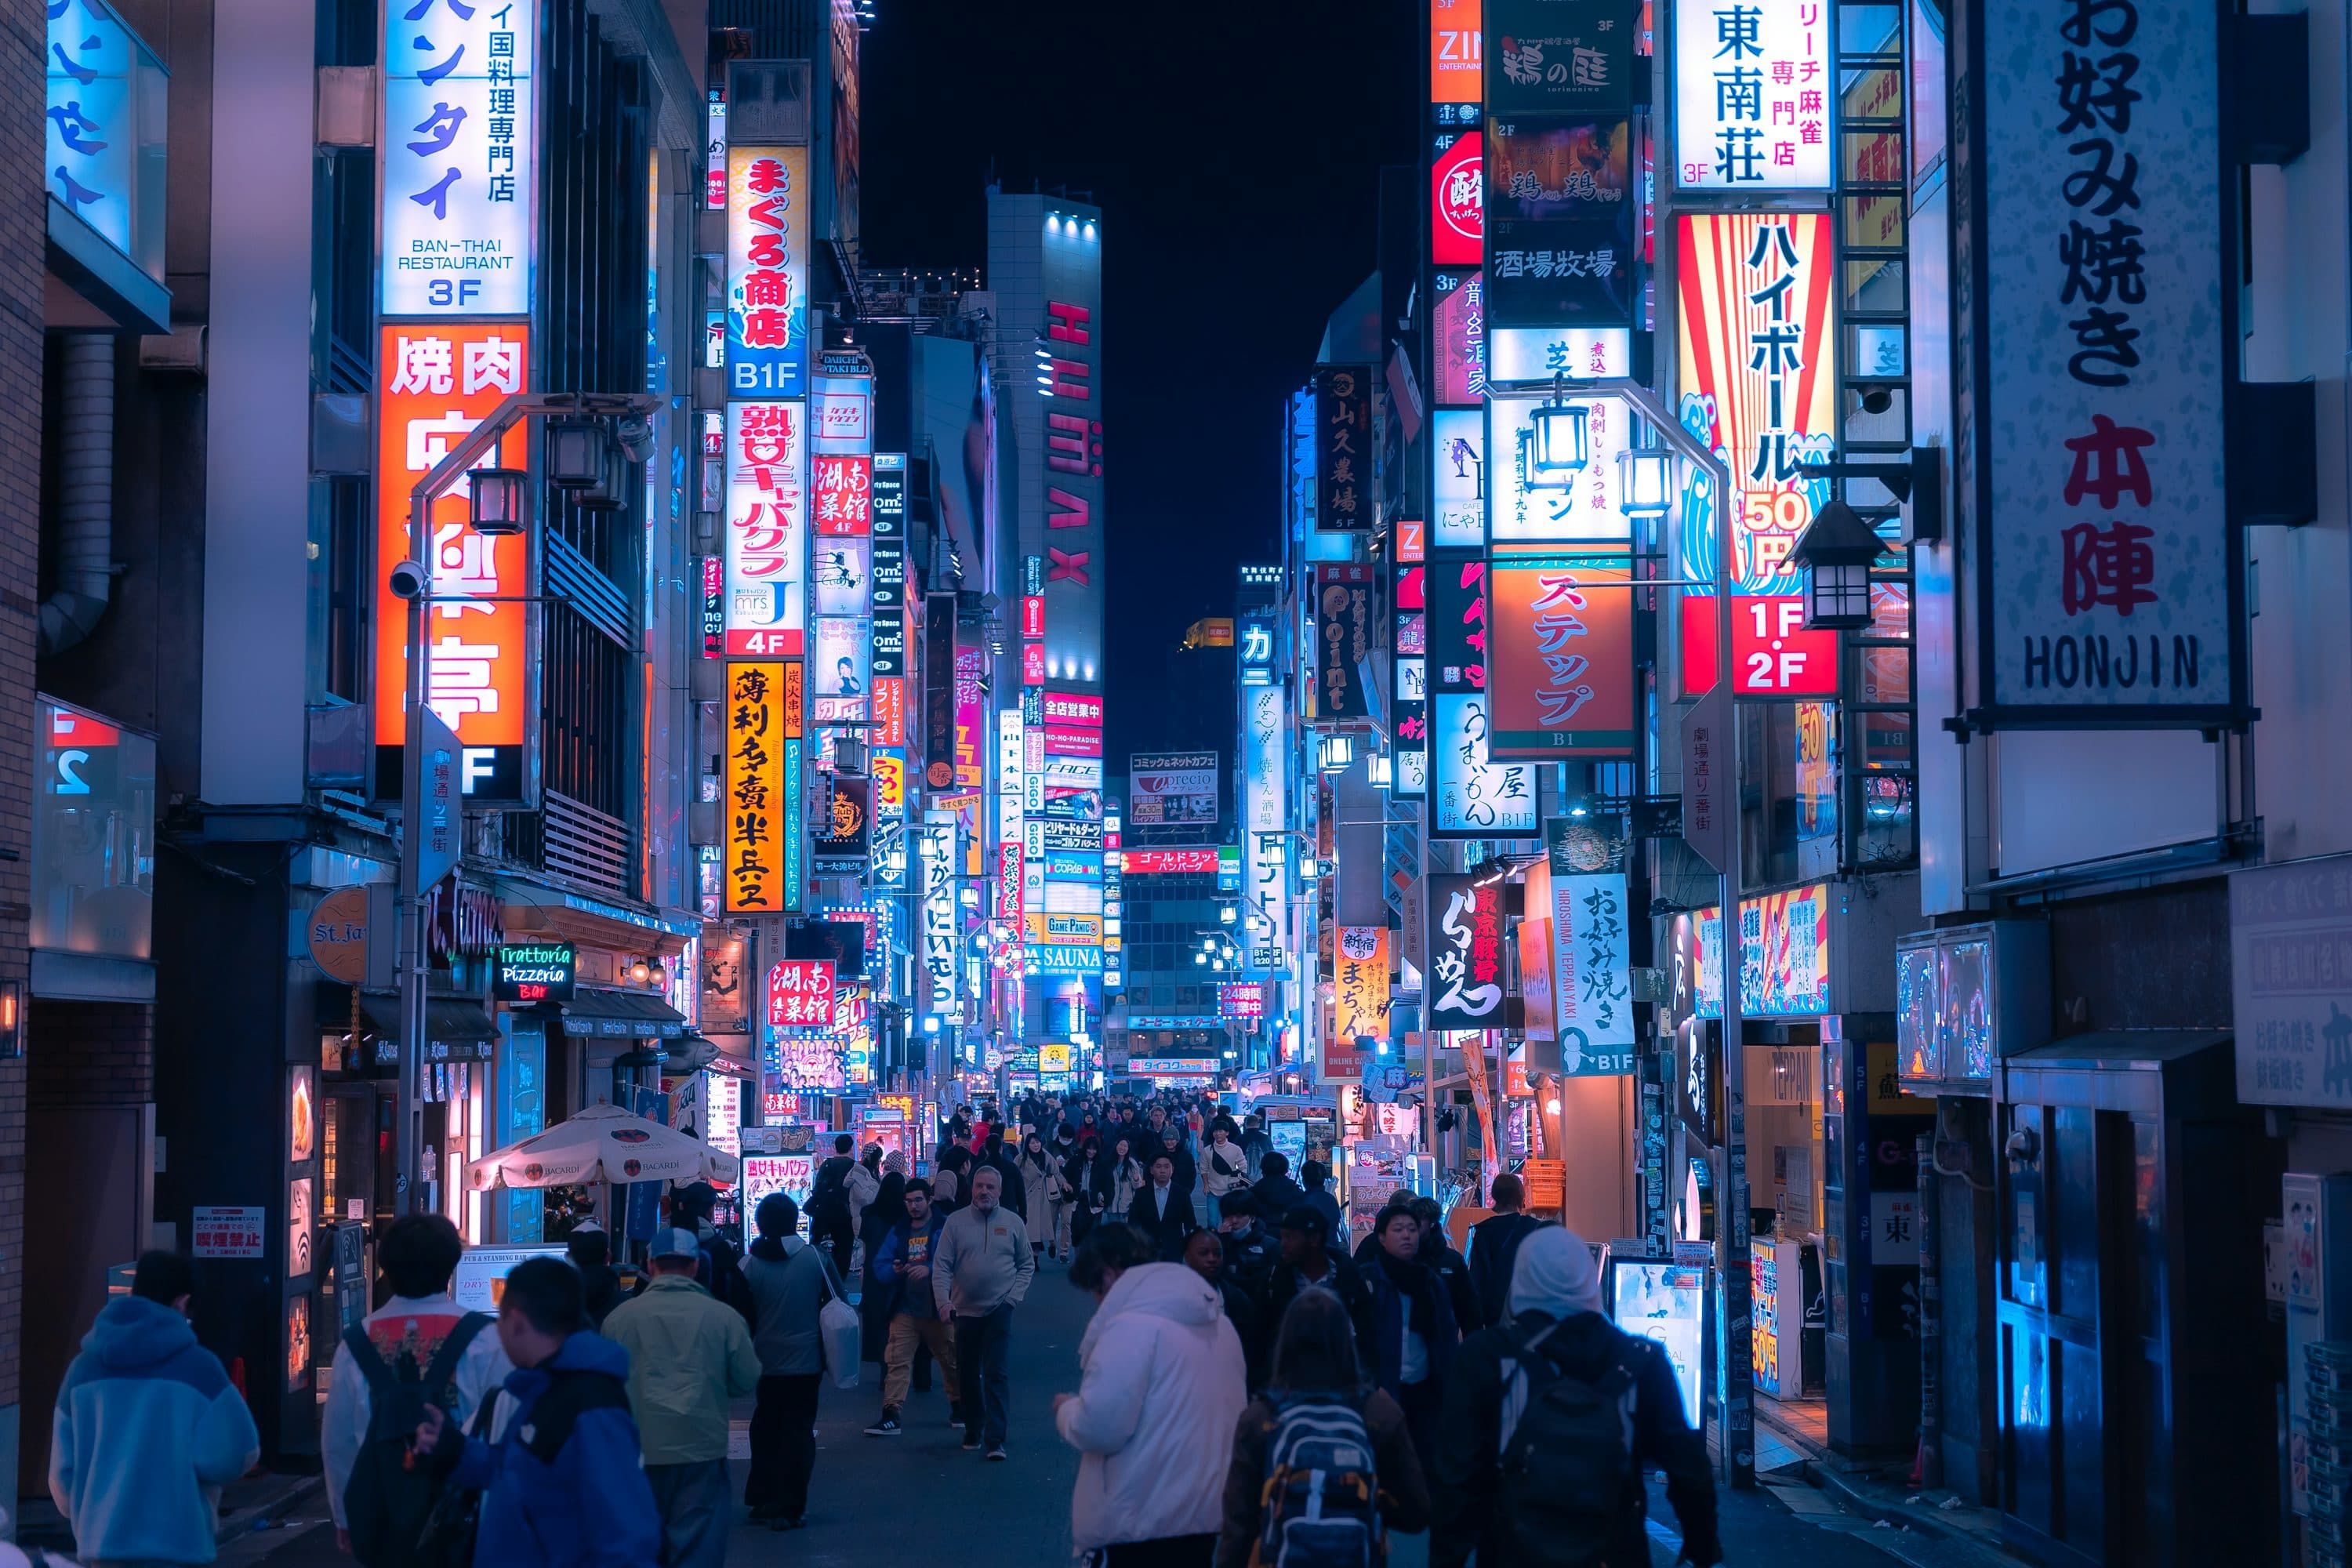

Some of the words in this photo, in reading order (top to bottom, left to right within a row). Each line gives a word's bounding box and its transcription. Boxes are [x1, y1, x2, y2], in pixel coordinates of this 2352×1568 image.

[1598, 20, 1613, 31] 3F
[1799, 4, 1823, 144] リーチ麻雀
[488, 3, 515, 201] イ国料理専門店
[1712, 5, 1765, 183] 東南荘
[1772, 60, 1795, 166] 専門店
[1436, 136, 1453, 149] 4F
[1498, 125, 1515, 136] 2F
[1684, 163, 1708, 183] 3F
[2054, 0, 2147, 387] お好み焼き
[412, 240, 501, 252] BAN-THAI
[746, 159, 788, 347] まぐろ商店
[398, 257, 514, 270] RESTAURANT
[1495, 250, 1616, 278] 酒場牧場
[428, 280, 481, 306] 3F
[1436, 275, 1457, 290] 3F
[390, 336, 522, 394] 焼肉
[1748, 224, 1800, 483] ハイボール
[735, 362, 797, 389] B1F
[1330, 401, 1356, 513] 山久農場
[818, 461, 868, 492] 湖南
[733, 405, 800, 578] 熟女キャバクラ
[834, 522, 852, 532] 4F
[1403, 525, 1419, 548] Z
[1328, 568, 1362, 579] 麻雀
[1751, 603, 1802, 637] 1F
[746, 632, 784, 653] 4F
[1530, 575, 1595, 725] ステップ
[1748, 652, 1806, 688] 2F
[2024, 635, 2198, 688] HONJIN
[786, 670, 800, 728] 炭火串焼
[1045, 700, 1099, 719] 全店営業中
[1552, 734, 1573, 745] B1
[1134, 757, 1214, 768] コミック&ネットカフェ
[1029, 776, 1039, 807] GiGO
[1693, 727, 1711, 831] 劇場通り一番街
[941, 796, 979, 809] 今すぐ見つかる
[1443, 782, 1458, 827] 一番街
[1501, 813, 1533, 826] B1F
[1029, 823, 1039, 855] GiGO
[815, 862, 862, 871] 第一大滝ビル
[1159, 863, 1203, 872] ハンバーグ
[502, 946, 570, 964] Trattoria
[1044, 948, 1102, 967] SAUNA
[1558, 889, 1568, 946] HIROSHIMA
[1565, 952, 1577, 1018] TEPPANYAKI
[1579, 887, 1628, 1029] お好み焼き
[503, 967, 564, 983] Pizzeria
[773, 963, 829, 993] 湖南
[519, 985, 546, 999] Bar
[1224, 989, 1261, 1000] 24時間
[1342, 962, 1366, 1036] まっちゃん
[1224, 1001, 1261, 1014] 営業中
[1598, 1054, 1633, 1070] B1F
[1772, 1051, 1809, 1101] TEPPAN
[747, 1160, 810, 1177] 熟女キャバクラ
